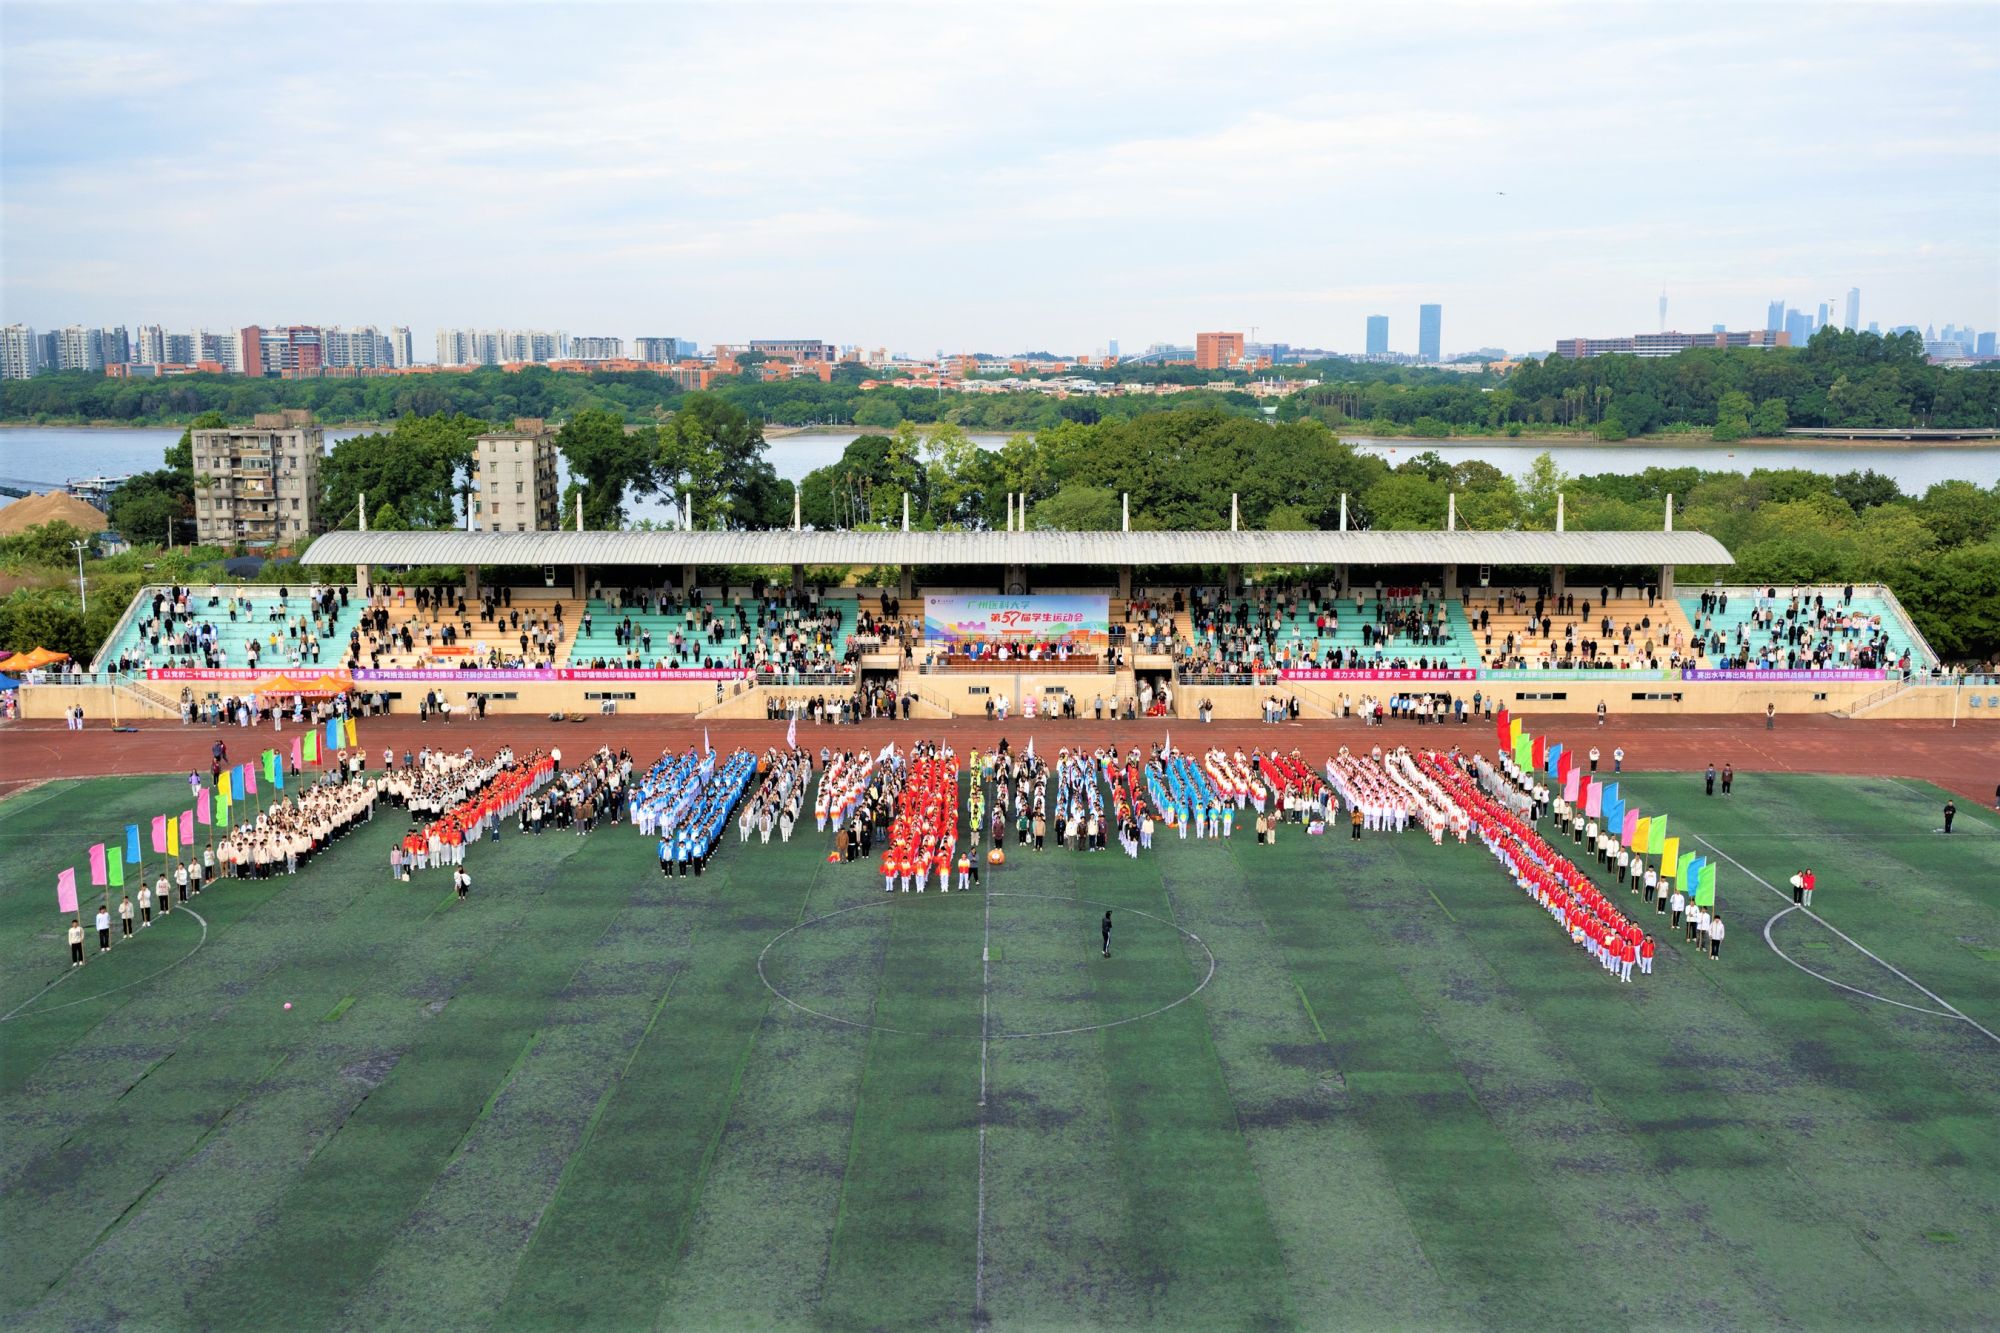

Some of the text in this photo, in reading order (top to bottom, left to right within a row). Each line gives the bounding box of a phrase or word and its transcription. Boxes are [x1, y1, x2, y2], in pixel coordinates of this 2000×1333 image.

[967, 600, 1031, 610] 广州医科大学
[990, 610, 1085, 627] 第57届学生运动会
